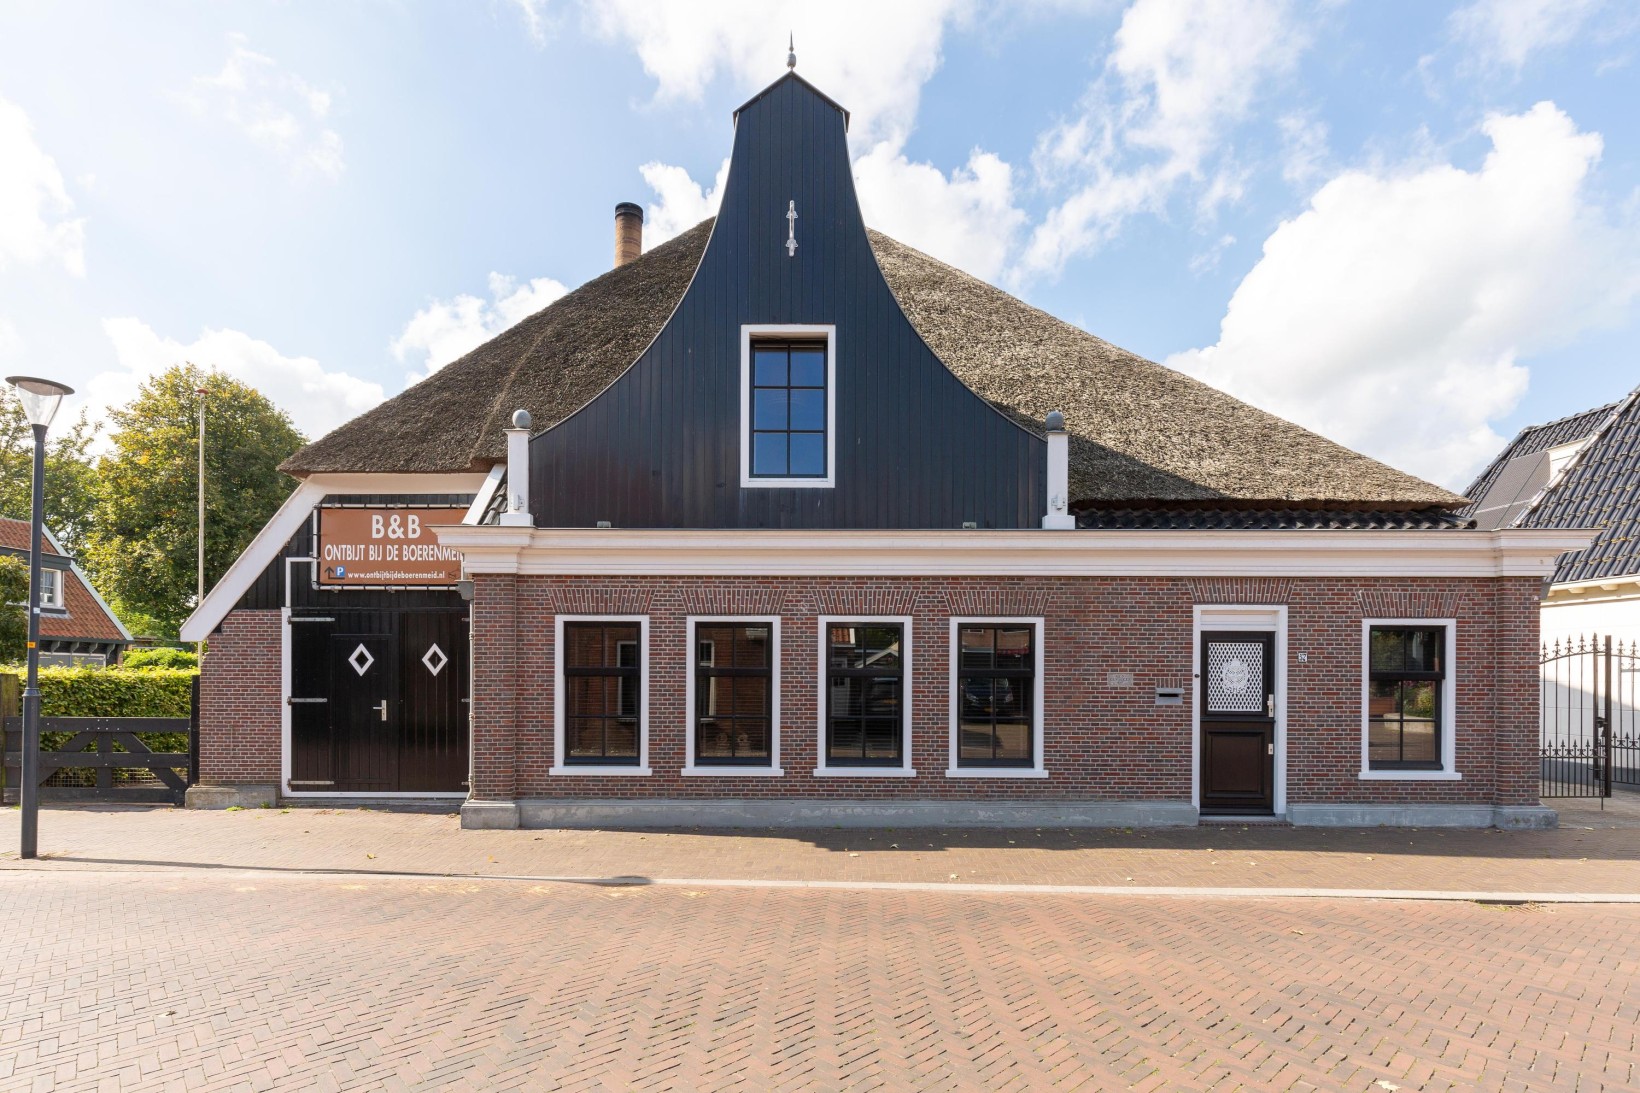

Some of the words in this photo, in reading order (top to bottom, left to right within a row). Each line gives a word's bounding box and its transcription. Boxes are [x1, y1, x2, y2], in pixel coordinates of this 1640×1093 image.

[371, 514, 421, 540] B&B
[324, 544, 366, 561] ONTBIJT
[368, 544, 383, 561] BIJ
[386, 544, 399, 561] DE
[336, 566, 344, 577] P
[347, 570, 445, 580] www.ontbijtbijdeboerenmeid.nl
